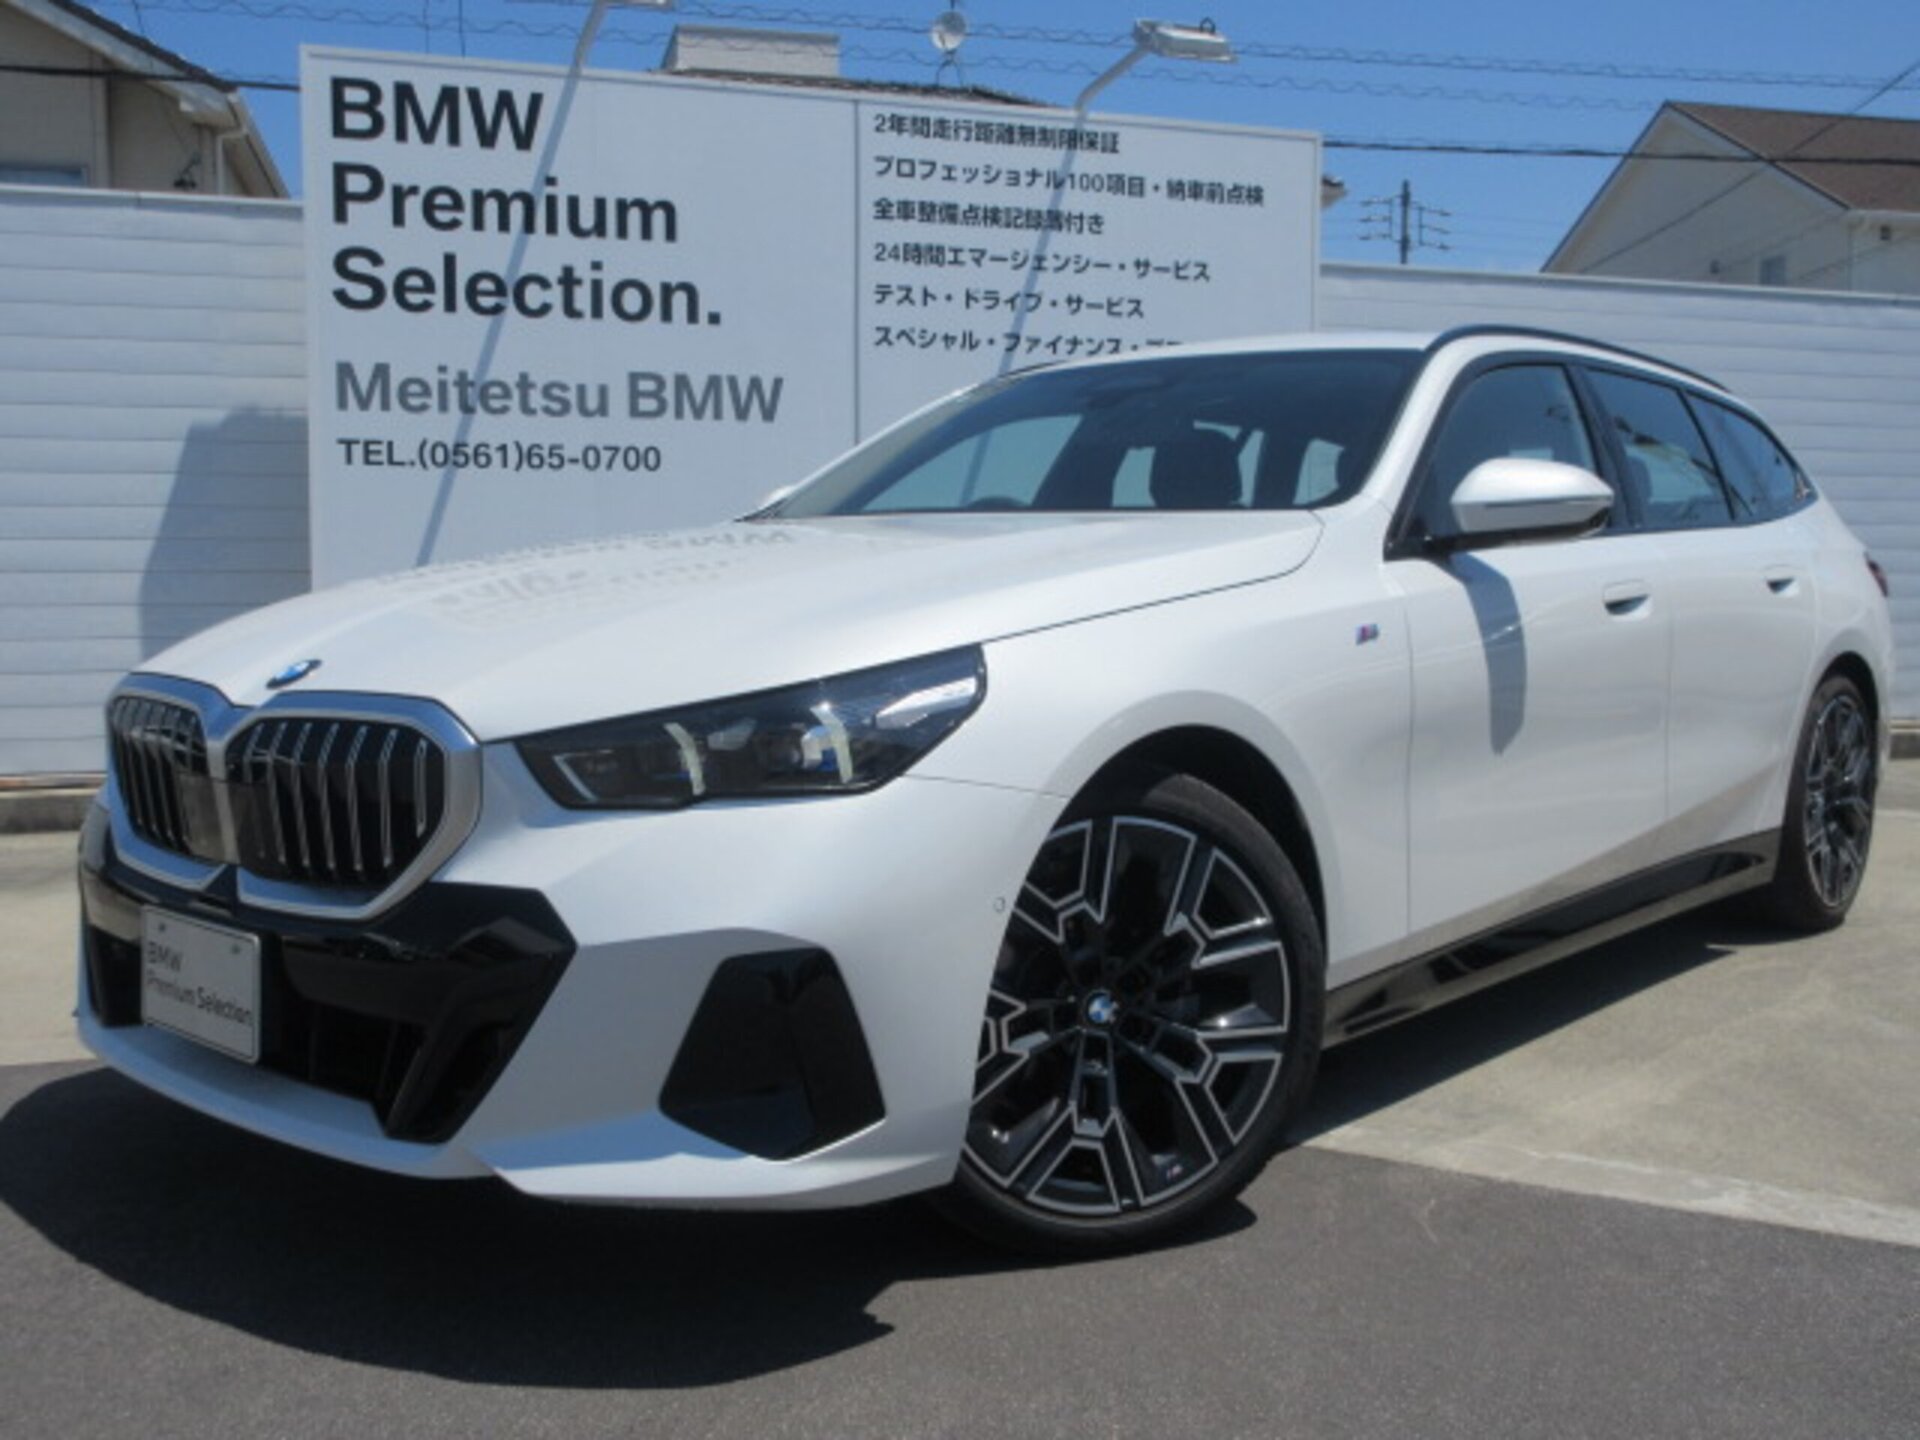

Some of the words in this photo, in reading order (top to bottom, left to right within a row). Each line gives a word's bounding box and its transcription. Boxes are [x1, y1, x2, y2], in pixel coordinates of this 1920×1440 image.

[330, 76, 543, 151] BMW
[873, 113, 1120, 153] 2年間走行距離無制限保証
[333, 162, 677, 242] Premium
[332, 246, 721, 325] Selection.
[874, 243, 1211, 282] 24時間エマージェンシー・サービス
[335, 361, 610, 418] Meitetsu
[627, 371, 784, 423] BMW
[337, 438, 662, 472] TEL.(0561)65-0700
[148, 941, 183, 972] BMW
